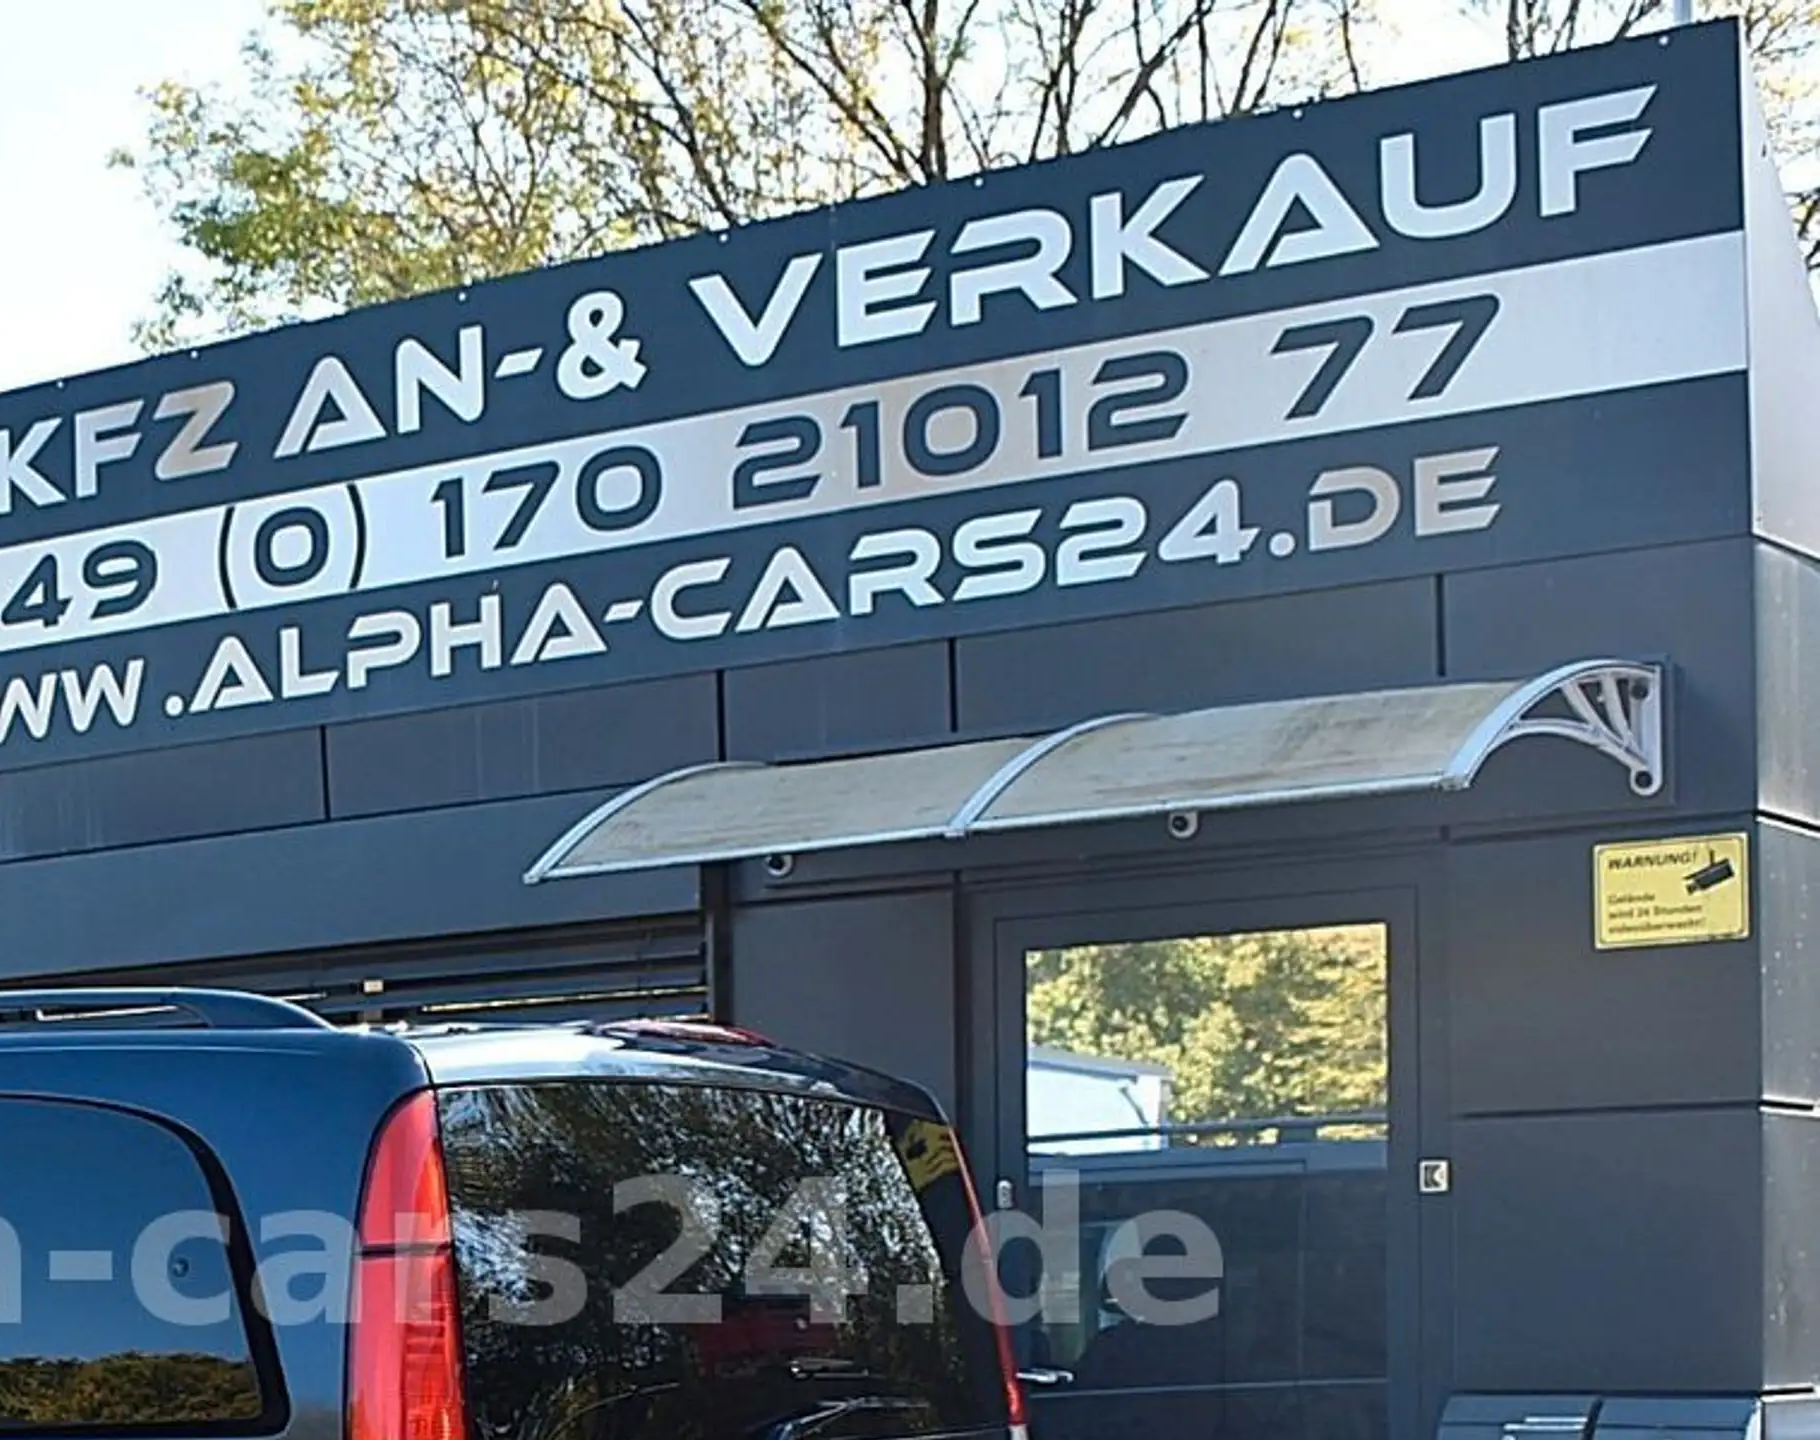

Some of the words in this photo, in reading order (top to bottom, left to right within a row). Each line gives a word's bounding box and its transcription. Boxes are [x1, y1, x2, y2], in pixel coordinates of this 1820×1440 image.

[688, 84, 1657, 368] VERKAUF
[218, 482, 366, 611] (0)
[431, 445, 664, 558] 170
[732, 350, 1190, 511] 21012
[1271, 292, 1502, 420] 77
[1607, 849, 1698, 871] WARNUNG!
